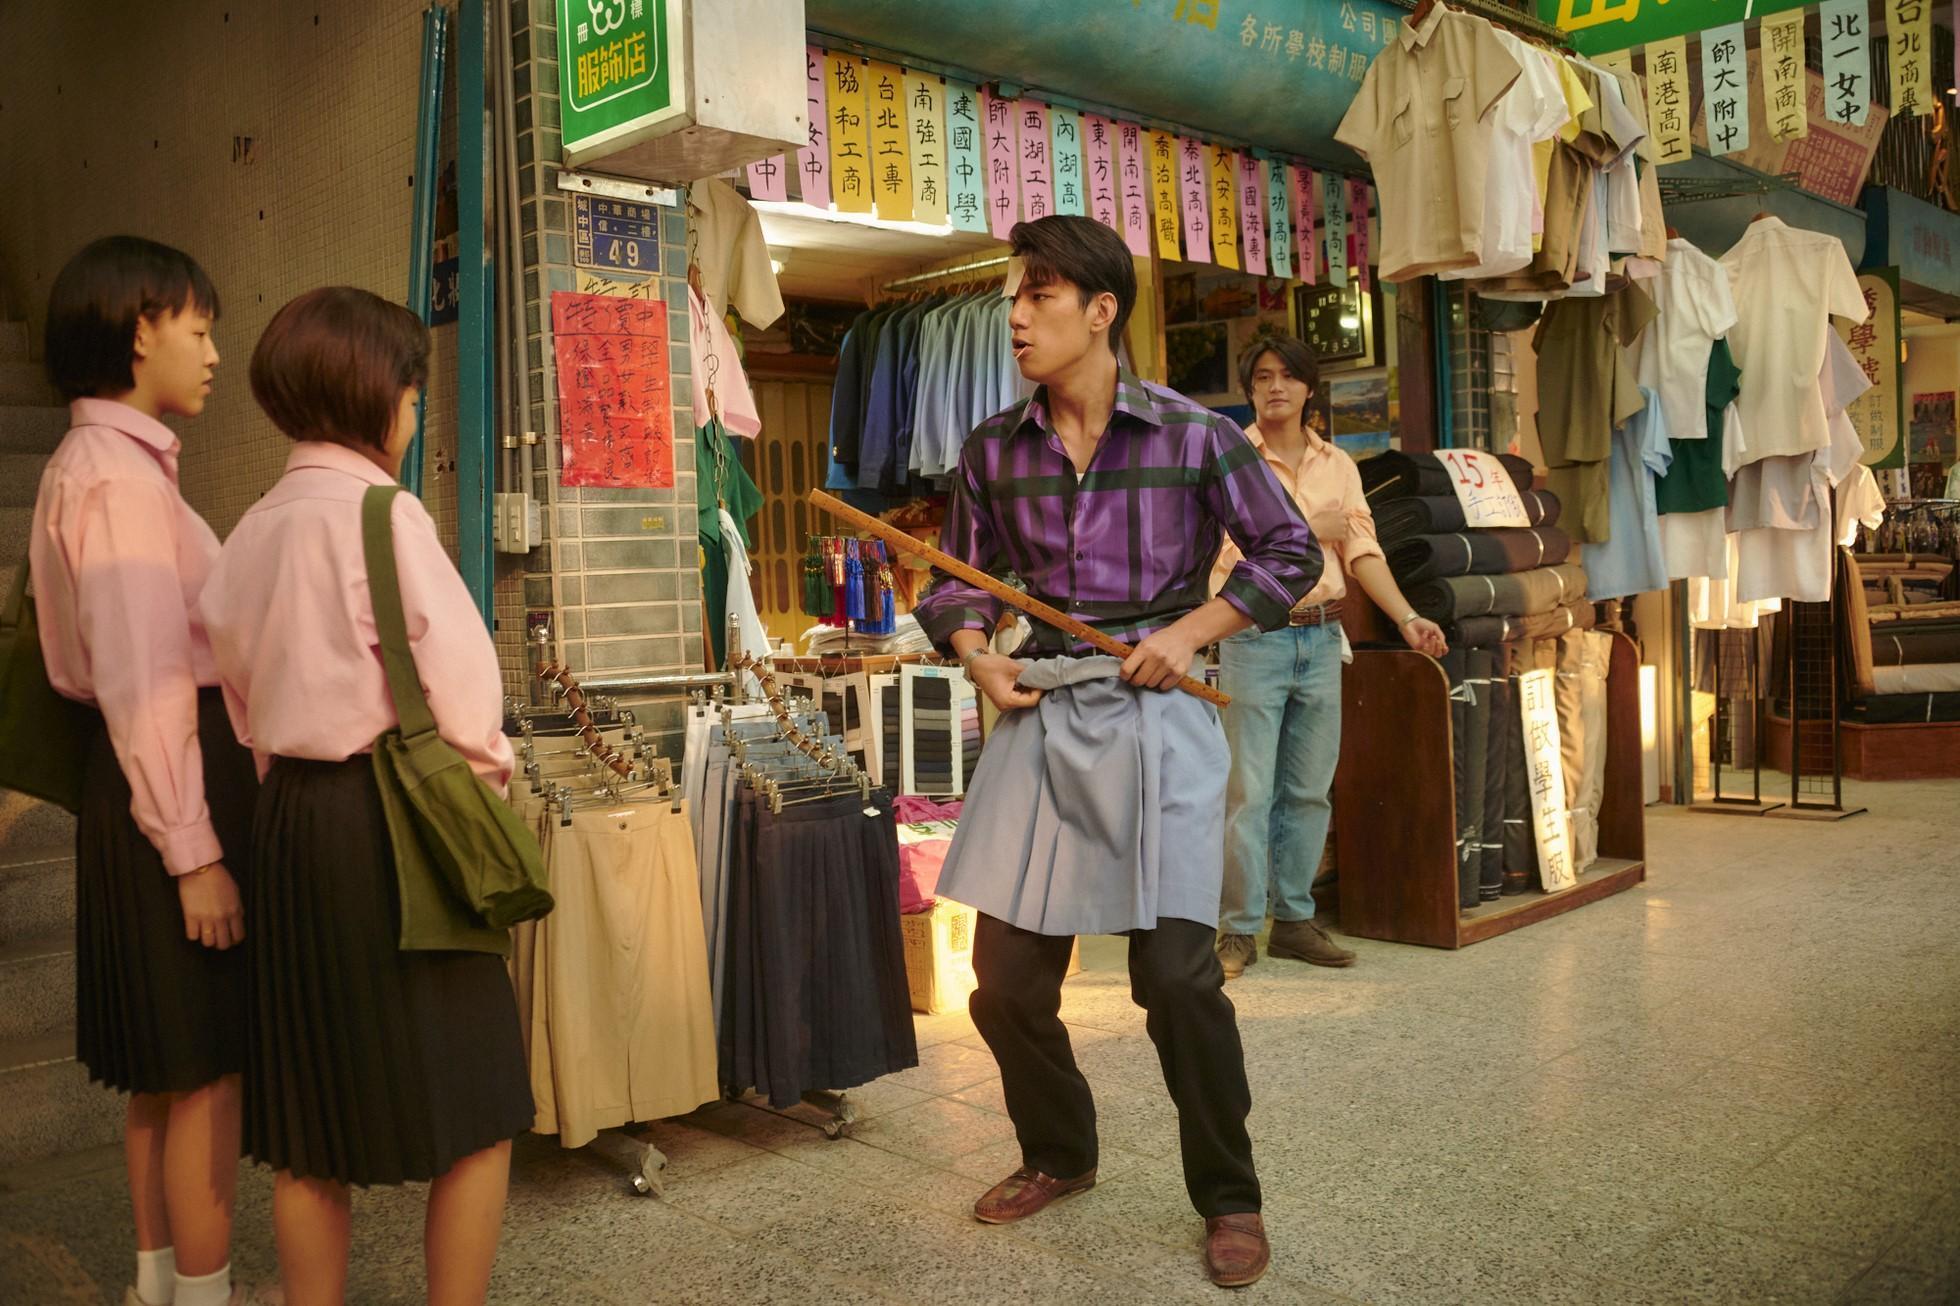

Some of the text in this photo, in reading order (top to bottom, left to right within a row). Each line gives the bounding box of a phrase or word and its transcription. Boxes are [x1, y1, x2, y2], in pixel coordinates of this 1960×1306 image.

[578, 31, 645, 97] 服飾店
[1240, 14, 1368, 81] 各所學校制服
[1712, 39, 1740, 151] 師大附中
[1830, 14, 1862, 123] 北一女中
[835, 61, 862, 197] 協和工商
[876, 76, 903, 194] 台北工專
[914, 82, 938, 205] 南強工商
[952, 91, 979, 223] 建國中學
[1653, 49, 1683, 159] 南港高工
[989, 99, 1010, 220] 師大附中
[1024, 110, 1046, 217] 西湖工商
[1056, 114, 1079, 212] 內湖高
[1123, 127, 1142, 230] 開南工商
[1155, 136, 1176, 244] 喬治高職
[1184, 139, 1203, 242] 泰北高中
[1214, 149, 1233, 246] 大安高工
[609, 239, 639, 267] 49
[1270, 159, 1288, 270] 成功高中
[1327, 174, 1343, 268] 南港高工
[1525, 675, 1570, 885] 訂做學生服
